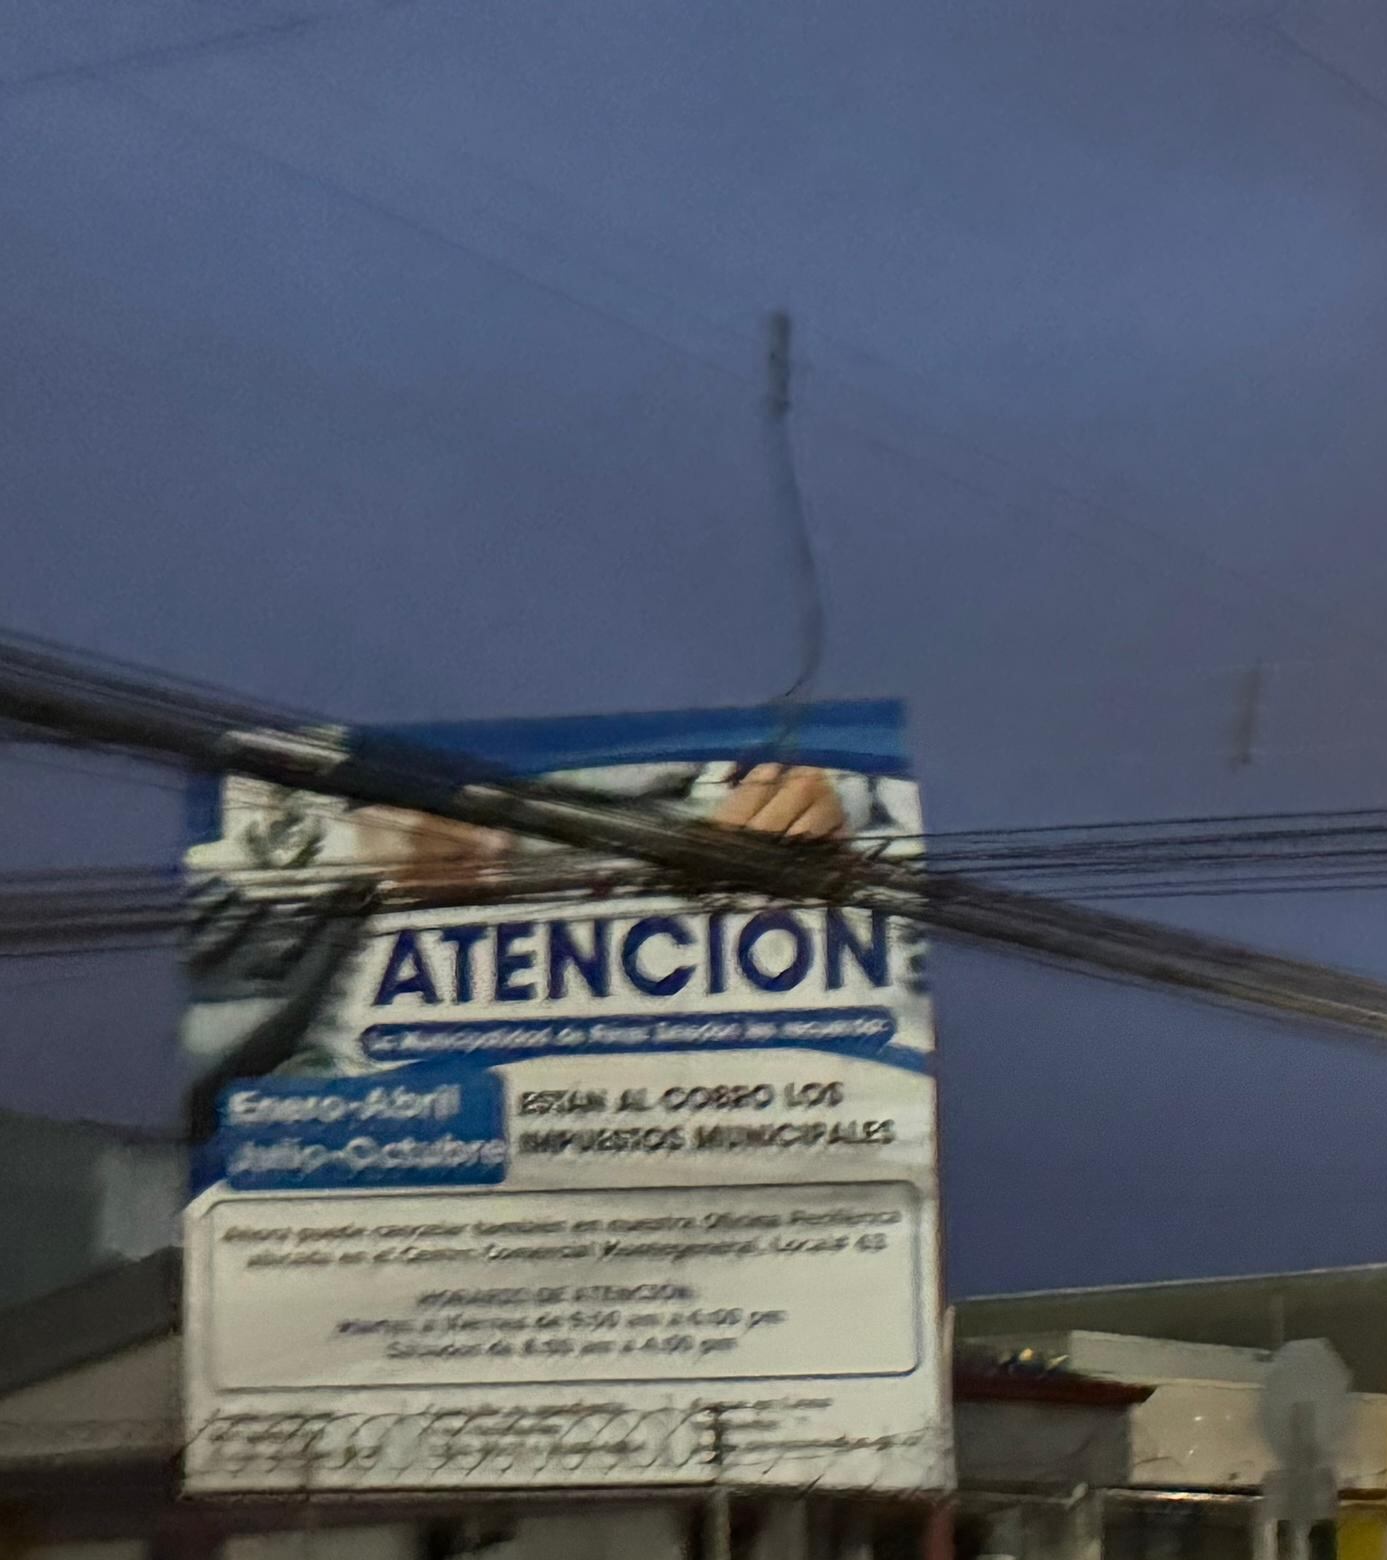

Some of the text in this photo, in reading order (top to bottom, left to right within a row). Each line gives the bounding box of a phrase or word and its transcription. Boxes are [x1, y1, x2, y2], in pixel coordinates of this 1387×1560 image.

[374, 908, 893, 1005] ATENCION
[783, 1080, 845, 1109] LOS
[519, 1119, 896, 1154] IMPUESTOS MUNICIPALES
